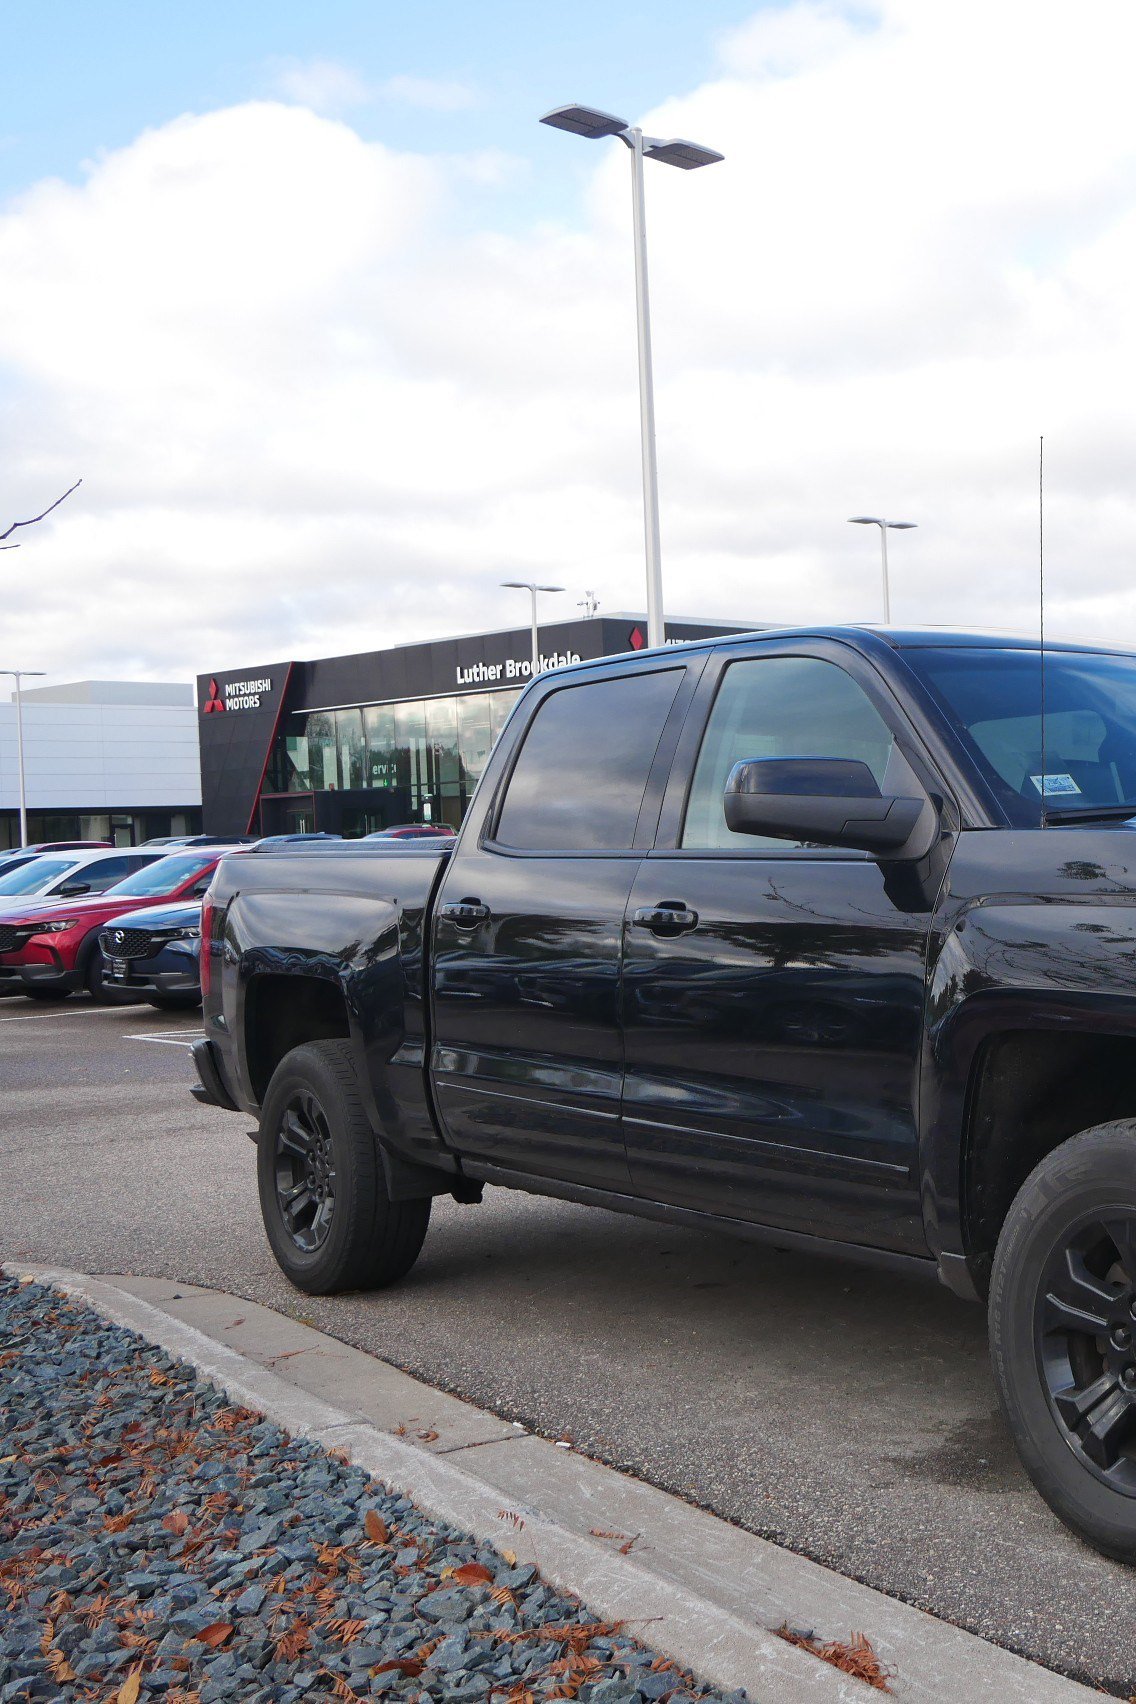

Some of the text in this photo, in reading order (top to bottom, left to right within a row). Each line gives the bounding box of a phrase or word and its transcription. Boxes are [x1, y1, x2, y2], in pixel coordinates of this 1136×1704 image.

[456, 662, 503, 684] Luther
[225, 678, 271, 697] MITSUBISHI
[226, 694, 260, 711] MOTORS
